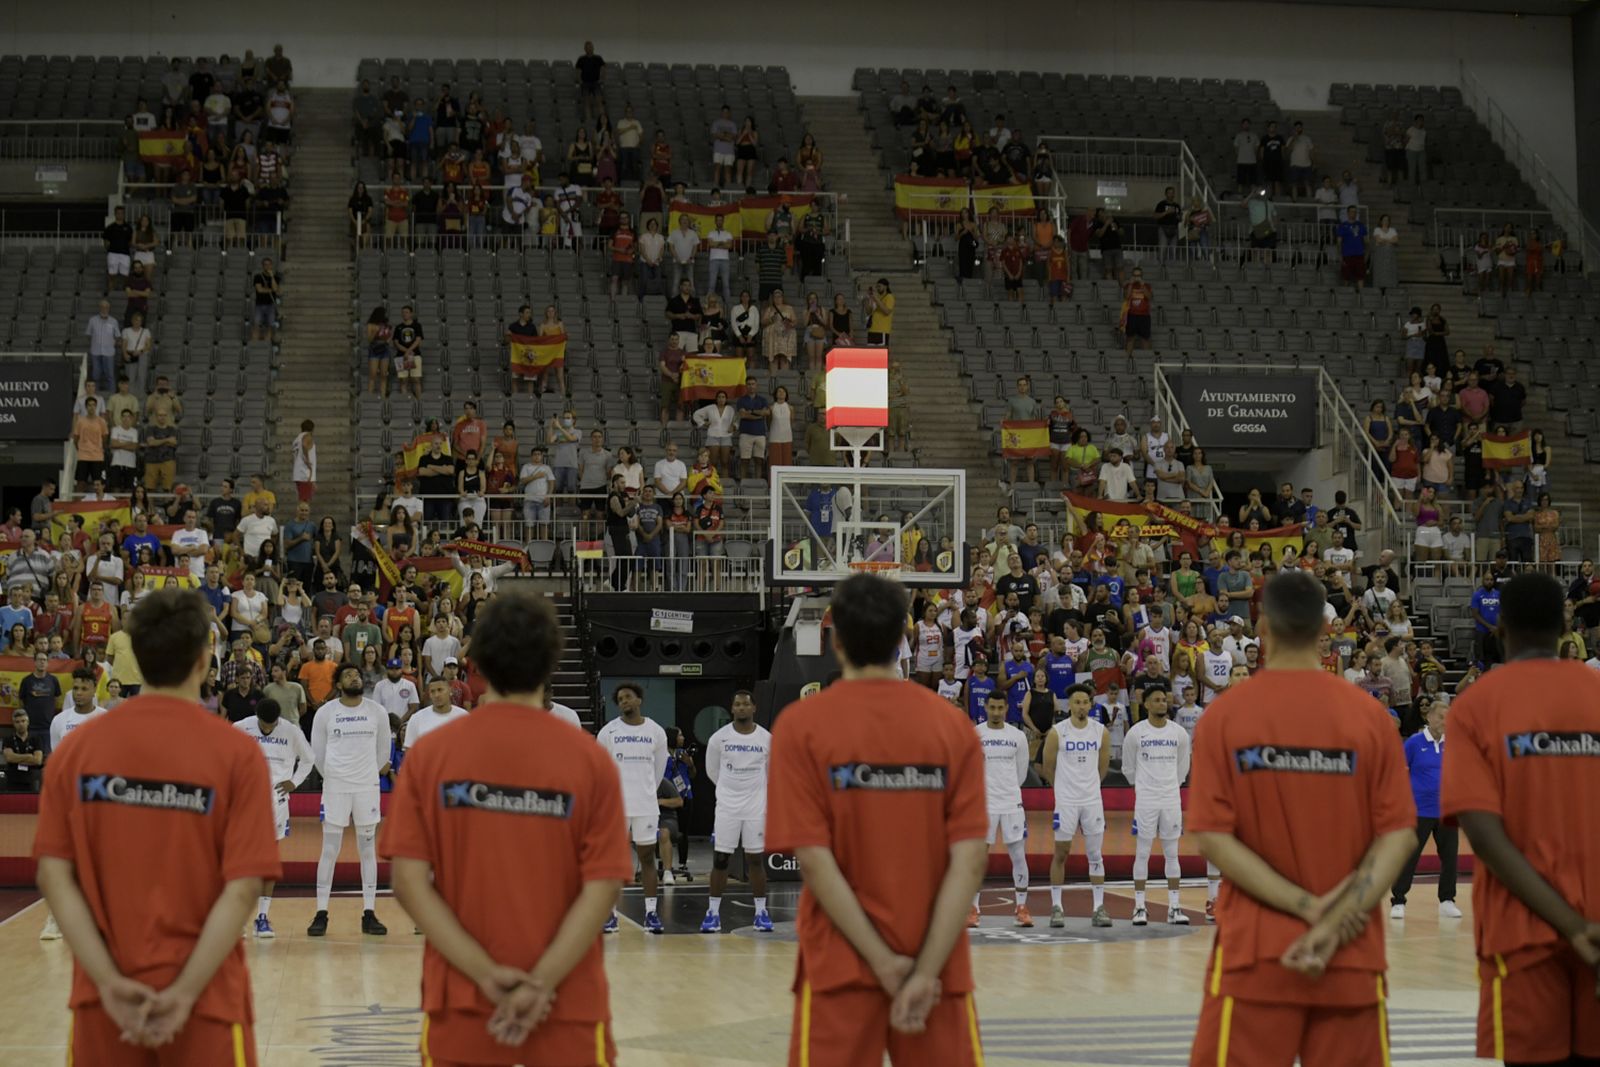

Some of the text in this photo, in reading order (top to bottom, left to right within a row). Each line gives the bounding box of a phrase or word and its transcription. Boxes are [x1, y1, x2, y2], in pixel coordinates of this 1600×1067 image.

[1199, 388, 1297, 403] AYUNTAMIENTO
[1227, 404, 1288, 418] GRANADA
[1212, 664, 1228, 677] 22
[613, 735, 653, 744] DOMINICANA
[1065, 740, 1099, 752] DOM
[1140, 739, 1178, 748] DOMINICANA
[724, 743, 764, 753] DOMINICANA
[1261, 745, 1352, 774] CaixaBank
[854, 763, 945, 791] CaixaBank
[106, 776, 208, 814] CaixaBank
[468, 783, 566, 817] CaixaBank
